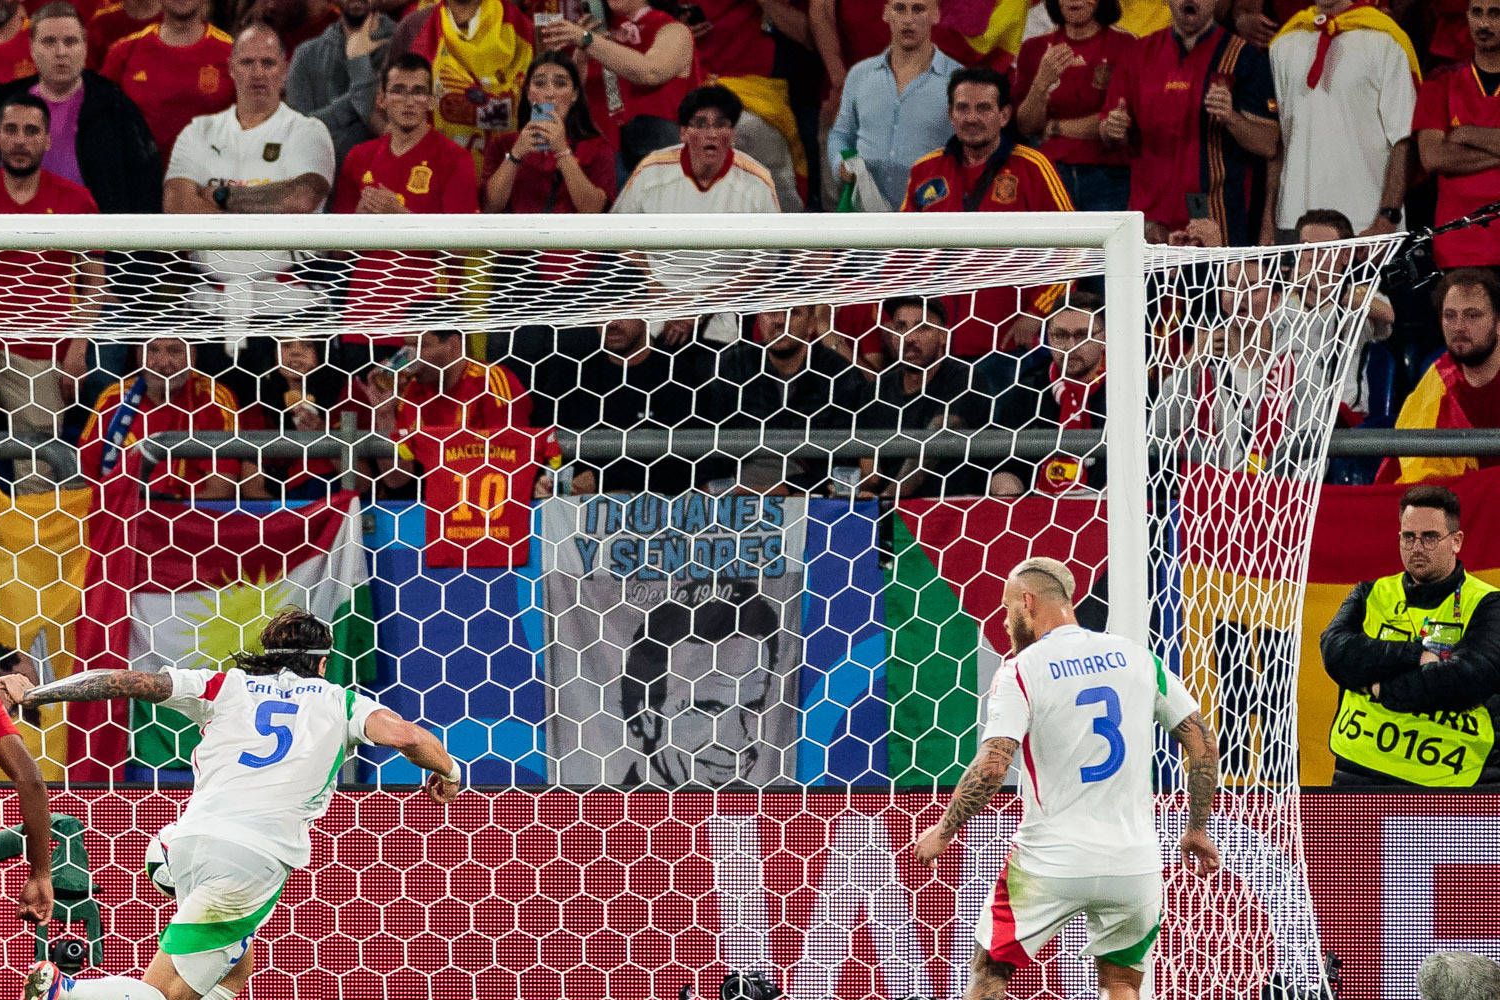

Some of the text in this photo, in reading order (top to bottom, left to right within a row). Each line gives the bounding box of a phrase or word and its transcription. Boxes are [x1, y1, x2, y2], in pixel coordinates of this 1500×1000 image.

[452, 473, 507, 521] 10
[575, 531, 787, 582] Y SEÑORES
[1049, 652, 1127, 680] DIMARCO
[238, 700, 300, 769] 5
[1075, 686, 1126, 784] 3
